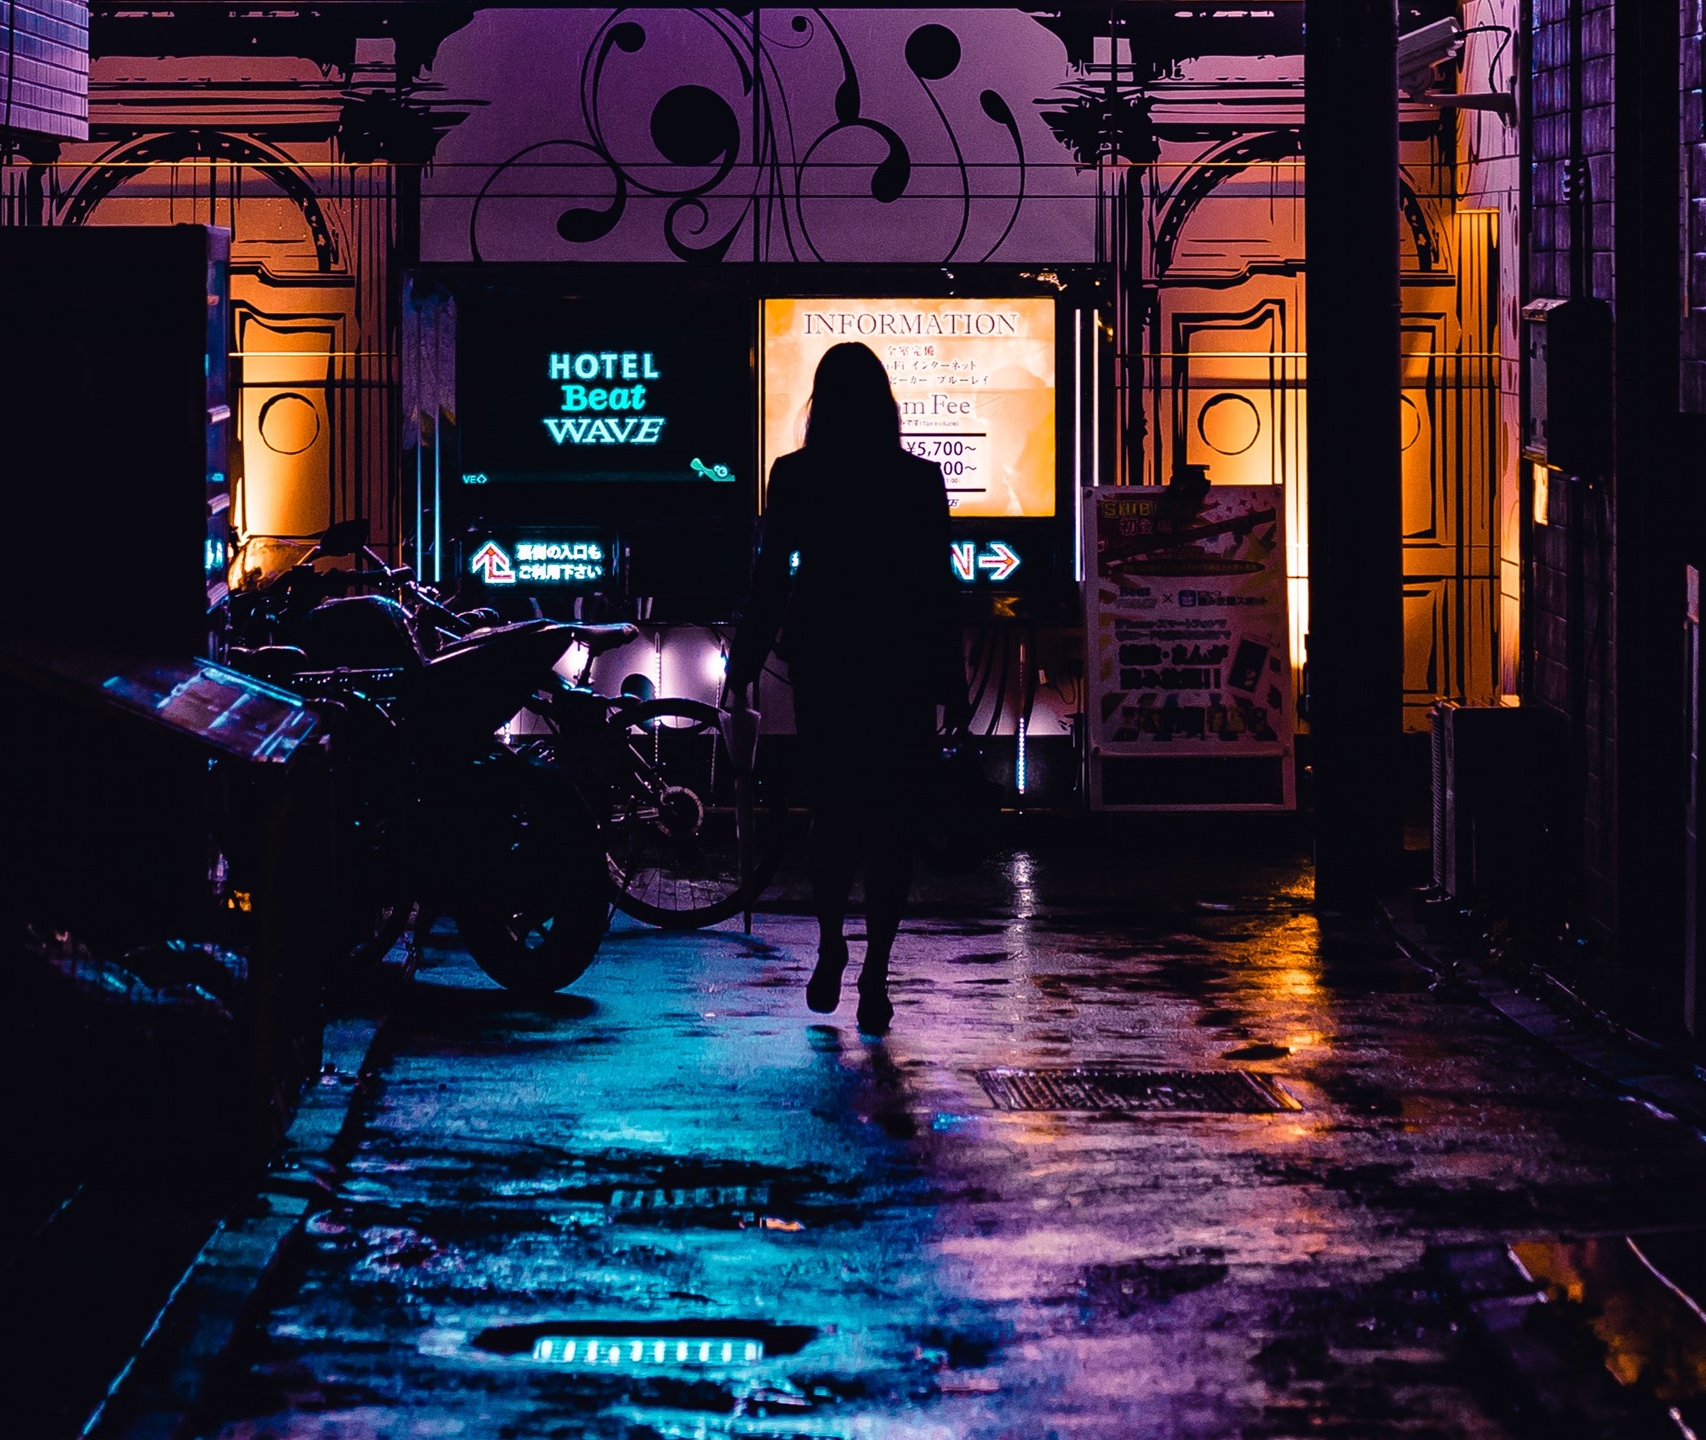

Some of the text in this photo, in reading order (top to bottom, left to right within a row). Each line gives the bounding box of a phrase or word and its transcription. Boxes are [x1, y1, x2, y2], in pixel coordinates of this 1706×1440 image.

[803, 312, 1019, 336] INFORMATION
[549, 352, 660, 379] HOTEL
[560, 384, 646, 412] Beat
[931, 394, 971, 414] Fee
[543, 417, 666, 444] WAVE
